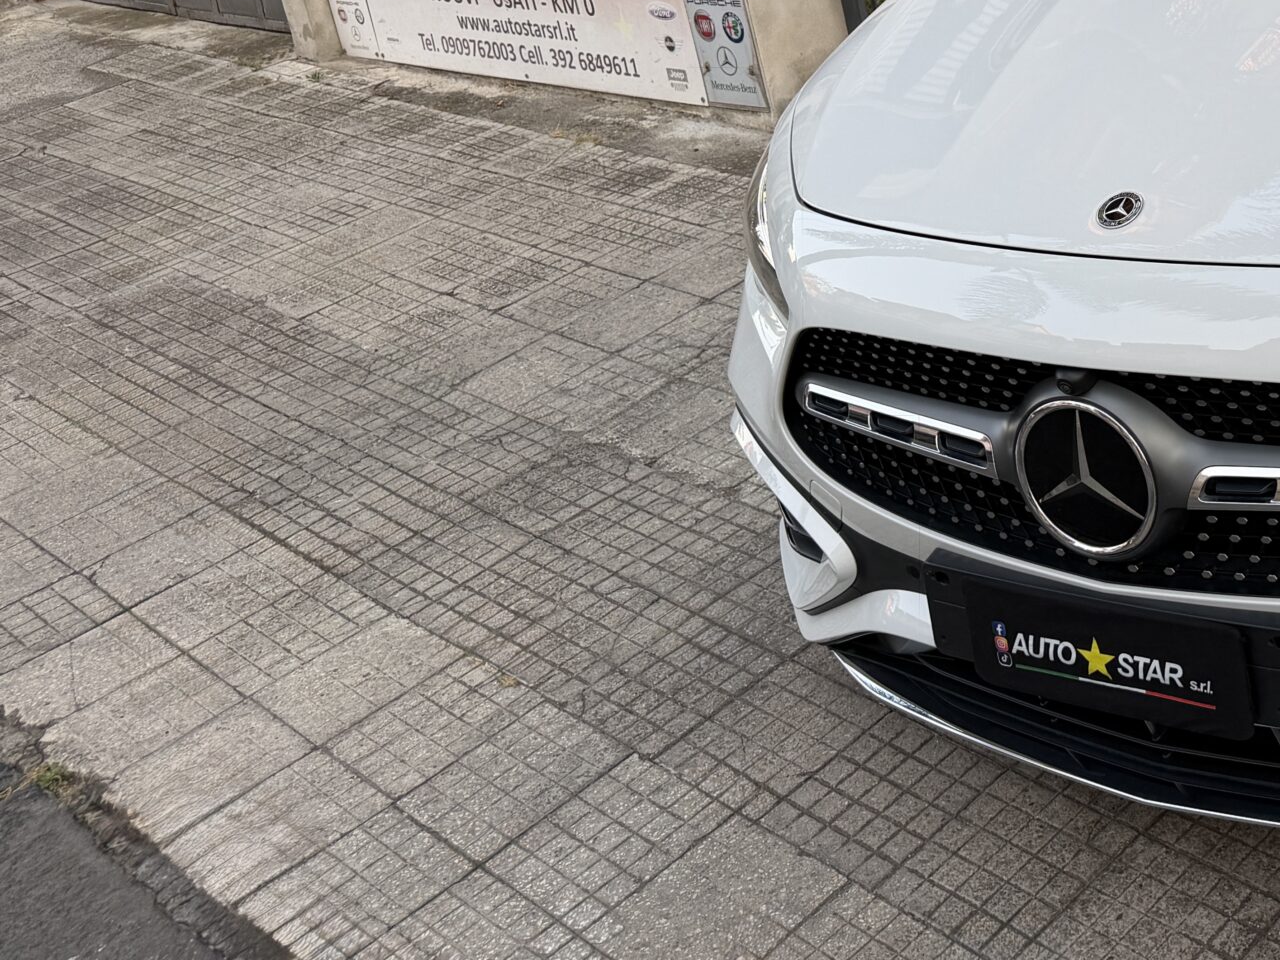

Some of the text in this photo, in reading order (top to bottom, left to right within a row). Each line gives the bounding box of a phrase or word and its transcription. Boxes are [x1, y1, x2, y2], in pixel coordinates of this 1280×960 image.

[456, 15, 578, 42] www.autostarsrl.it
[418, 33, 641, 78] Tel. 0909762003 Cell. 392 6849611
[669, 70, 685, 80] Jeep
[711, 80, 759, 94] Mercedes-Benz
[1011, 632, 1214, 695] AUTO STAR s.r.l.
